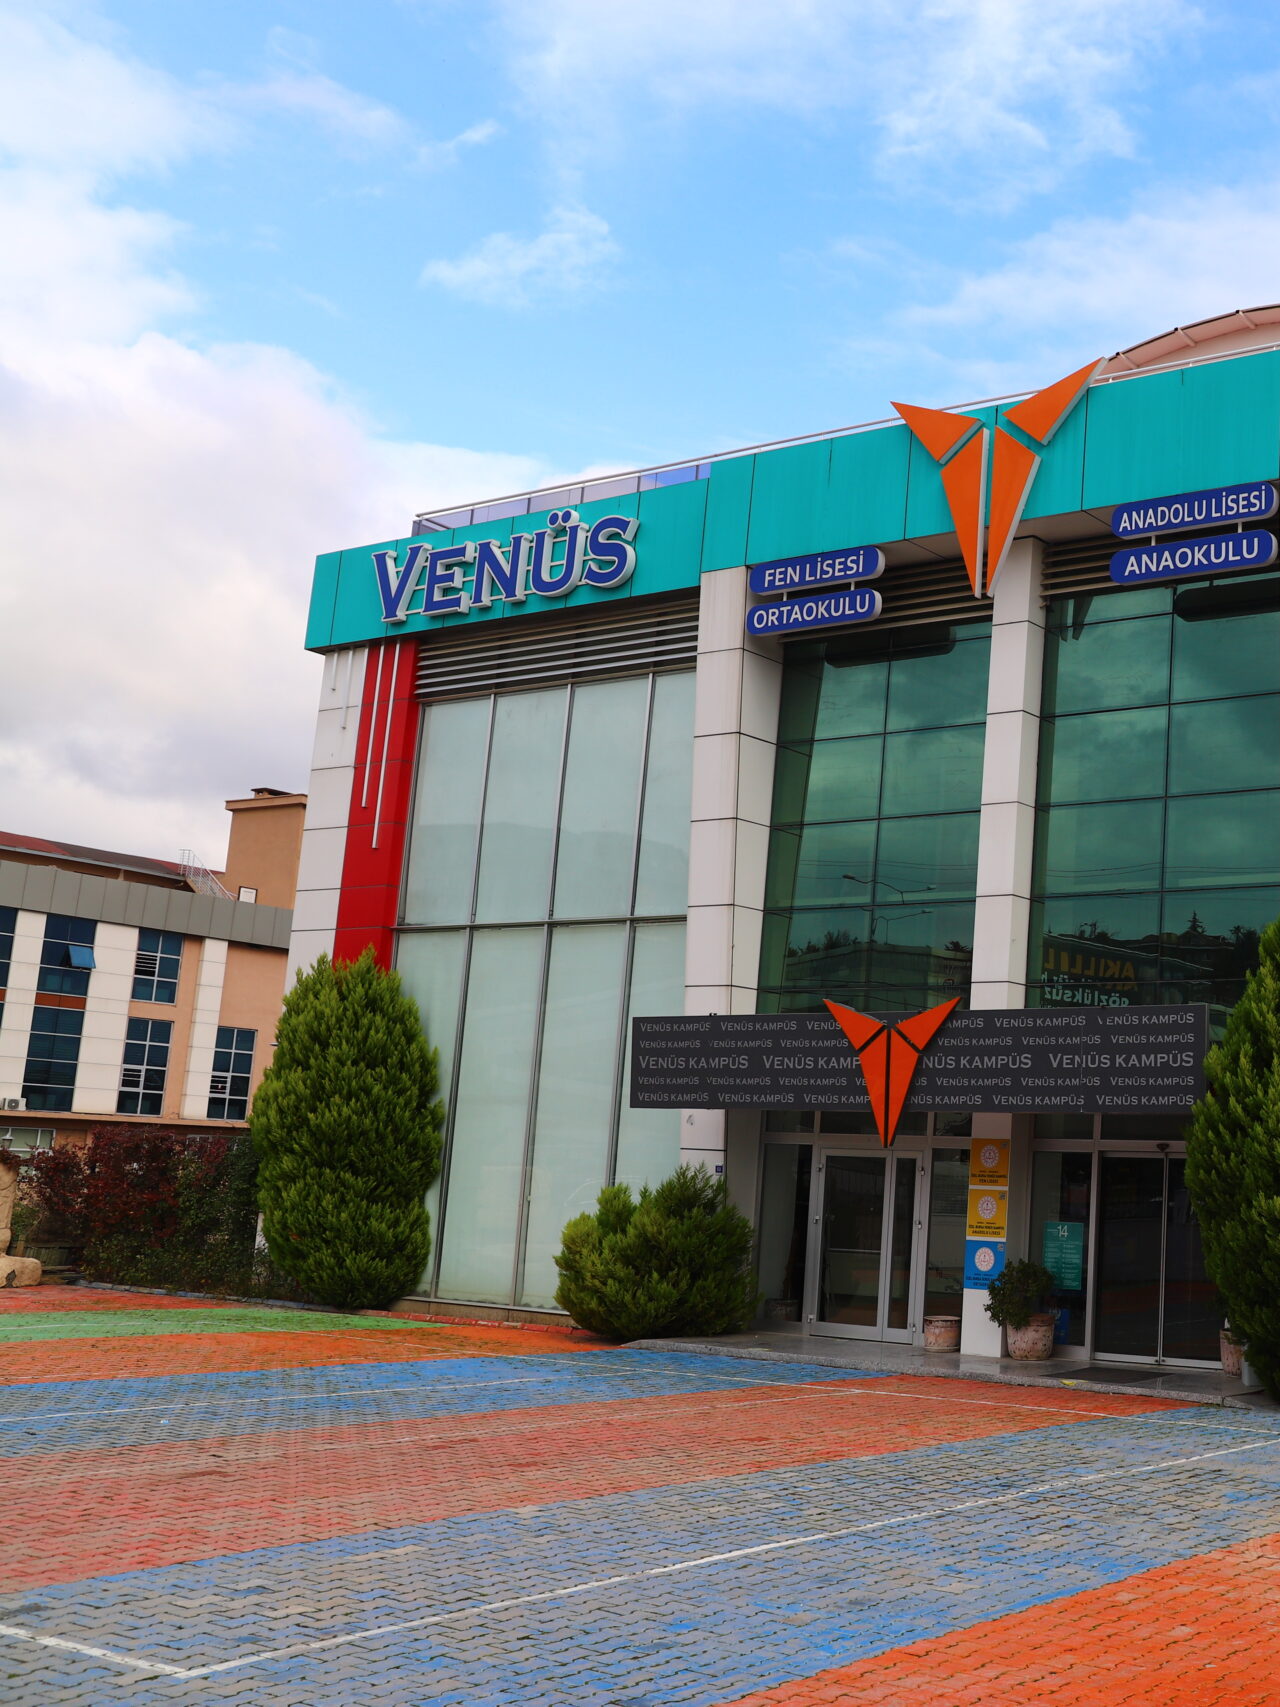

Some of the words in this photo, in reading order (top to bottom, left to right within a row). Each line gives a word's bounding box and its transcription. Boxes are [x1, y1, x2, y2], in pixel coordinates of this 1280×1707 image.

[1118, 498, 1208, 533] ANADOLU
[1208, 484, 1268, 517] LİSESİ
[371, 508, 640, 623] VENÜS
[763, 564, 802, 588] FEN
[805, 550, 864, 581] LİSESİ
[1124, 537, 1260, 576] ANAOKULU
[753, 594, 871, 629] ORTAOKULU
[640, 1022, 671, 1032] VENÜS
[673, 1022, 711, 1032] KAMPÜS
[720, 1021, 754, 1031] VENÜS
[755, 1021, 797, 1031] KAMPÜS
[994, 1017, 1034, 1028] VENÜS
[1036, 1016, 1086, 1027] KAMPÜS
[1142, 1013, 1195, 1025] KAMPÜS
[639, 1040, 666, 1049] VENÜS
[667, 1040, 701, 1049] KAMPÜS
[737, 1039, 773, 1048] KAMPÜS
[780, 1039, 810, 1048] VENÜS
[812, 1039, 849, 1048] KAMPÜS
[938, 1037, 970, 1046] VENÜS
[971, 1037, 1013, 1046] KAMPÜS
[1022, 1036, 1056, 1046] VENÜS
[1111, 1034, 1147, 1044] VENÜS
[1149, 1033, 1195, 1043] KAMPÜS
[638, 1055, 686, 1069] VENÜS
[689, 1055, 749, 1069] KAMPÜS
[763, 1055, 814, 1069] VENÜS
[818, 1057, 861, 1069] KAMP
[922, 1053, 956, 1069] NÜS
[960, 1053, 1032, 1069] KAMPÜS
[1048, 1052, 1110, 1068] VENÜS
[1115, 1051, 1194, 1068] KAMPÜS
[638, 1076, 665, 1085] VENÜS
[666, 1077, 700, 1085] KAMPÜS
[706, 1077, 734, 1085] VENÜS
[736, 1077, 771, 1086] KAMPÜS
[778, 1077, 808, 1086] VENÜS
[810, 1077, 847, 1086] KAMPÜS
[936, 1077, 969, 1086] VENÜS
[970, 1077, 1012, 1087] KAMPÜS
[1021, 1077, 1055, 1087] VENÜS
[1110, 1076, 1147, 1086] VENÜS
[1149, 1076, 1195, 1086] KAMPÜS
[638, 1092, 669, 1102] VENÜS
[670, 1092, 709, 1102] KAMPÜS
[718, 1093, 752, 1103] VENÜS
[754, 1093, 794, 1103] KAMPÜS
[803, 1094, 839, 1104] VENÜS
[841, 1096, 870, 1104] KAMP
[910, 1094, 932, 1105] NÜS
[935, 1095, 982, 1105] KAMPÜS
[992, 1095, 1032, 1105] VENÜS
[1096, 1095, 1139, 1106] VENÜS
[1141, 1095, 1195, 1106] KAMPÜS
